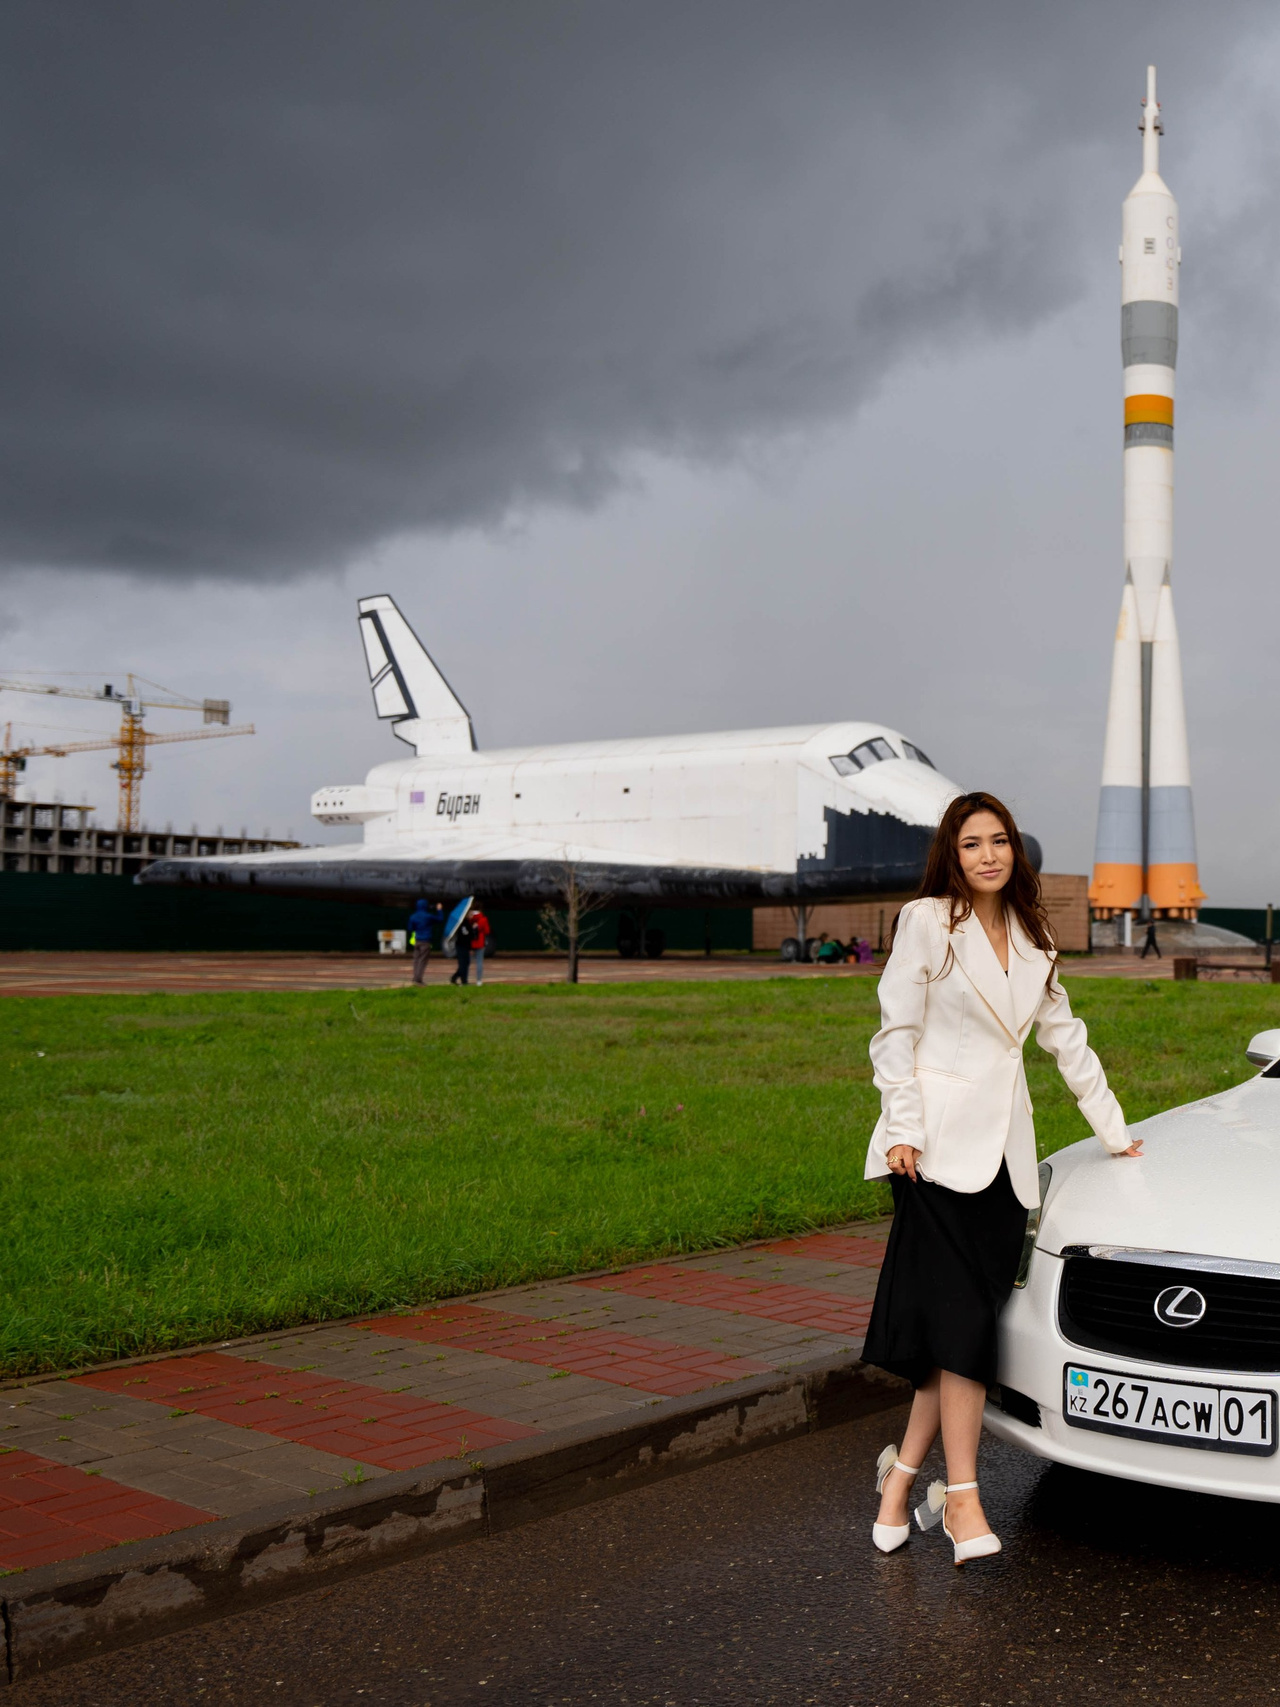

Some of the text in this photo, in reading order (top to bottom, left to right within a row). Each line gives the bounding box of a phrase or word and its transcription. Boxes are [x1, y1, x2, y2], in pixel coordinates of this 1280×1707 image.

[436, 792, 480, 821] Буран
[1070, 1395, 1087, 1413] KZ
[1224, 1397, 1267, 1439] 01
